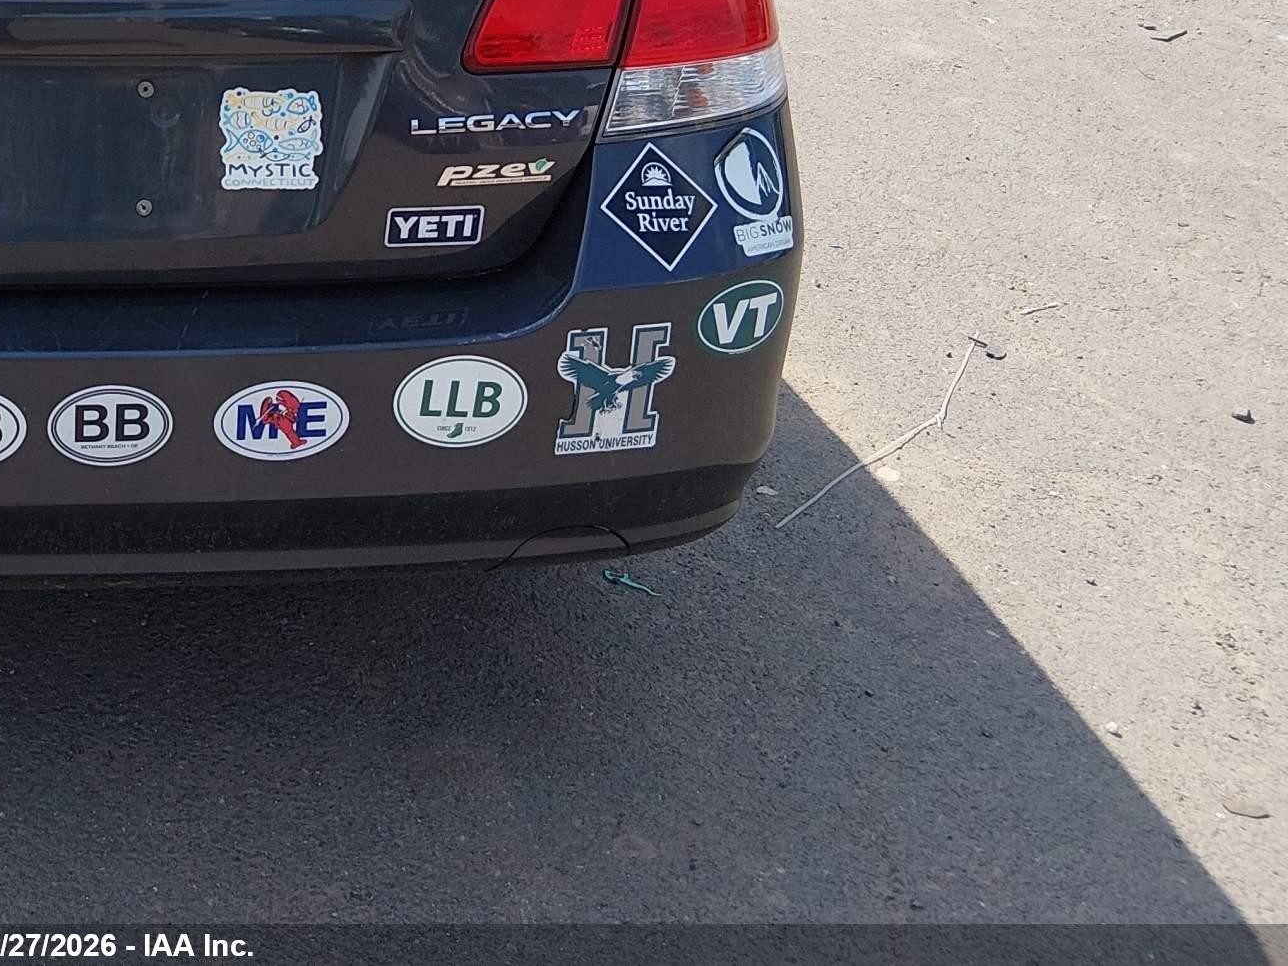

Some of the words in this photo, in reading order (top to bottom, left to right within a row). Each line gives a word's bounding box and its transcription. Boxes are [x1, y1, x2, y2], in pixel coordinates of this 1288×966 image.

[411, 109, 581, 136] LEGACY
[224, 179, 315, 187] CONNECTICUT
[229, 163, 311, 177] MYSTIC
[625, 188, 695, 215] Sunday
[394, 215, 474, 240] YETI
[636, 213, 689, 232] River
[712, 292, 778, 345] VT
[419, 379, 503, 419] LLB
[74, 403, 151, 443] BB
[556, 438, 597, 453] HUSSON
[598, 434, 654, 450] UNIVERSITY
